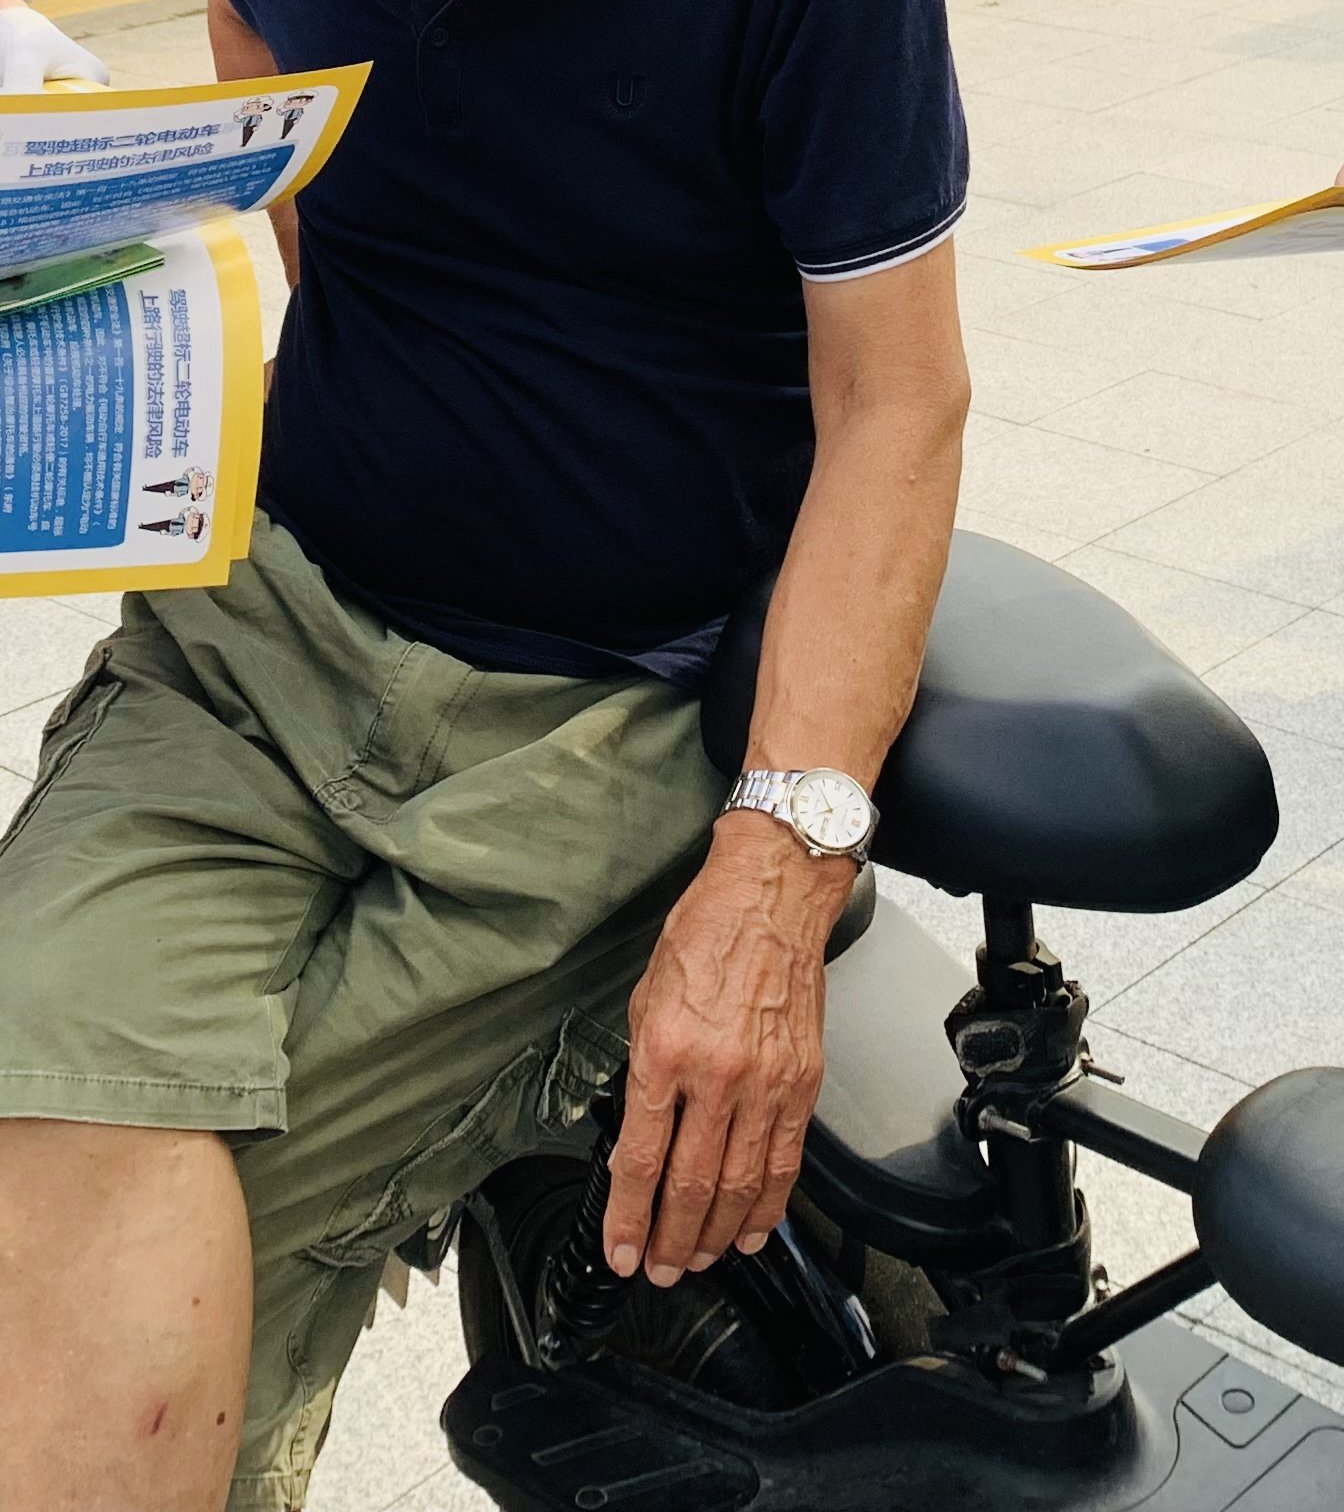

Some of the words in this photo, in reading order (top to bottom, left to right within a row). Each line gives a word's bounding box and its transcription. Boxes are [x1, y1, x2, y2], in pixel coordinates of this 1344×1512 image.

[20, 142, 215, 181] 上路行驶的法律风险
[24, 124, 221, 156] 驾驶超标二轮电动车
[140, 289, 165, 460] 上路行驶的法律风险
[169, 289, 193, 458] 驾驶超标二轮电动车
